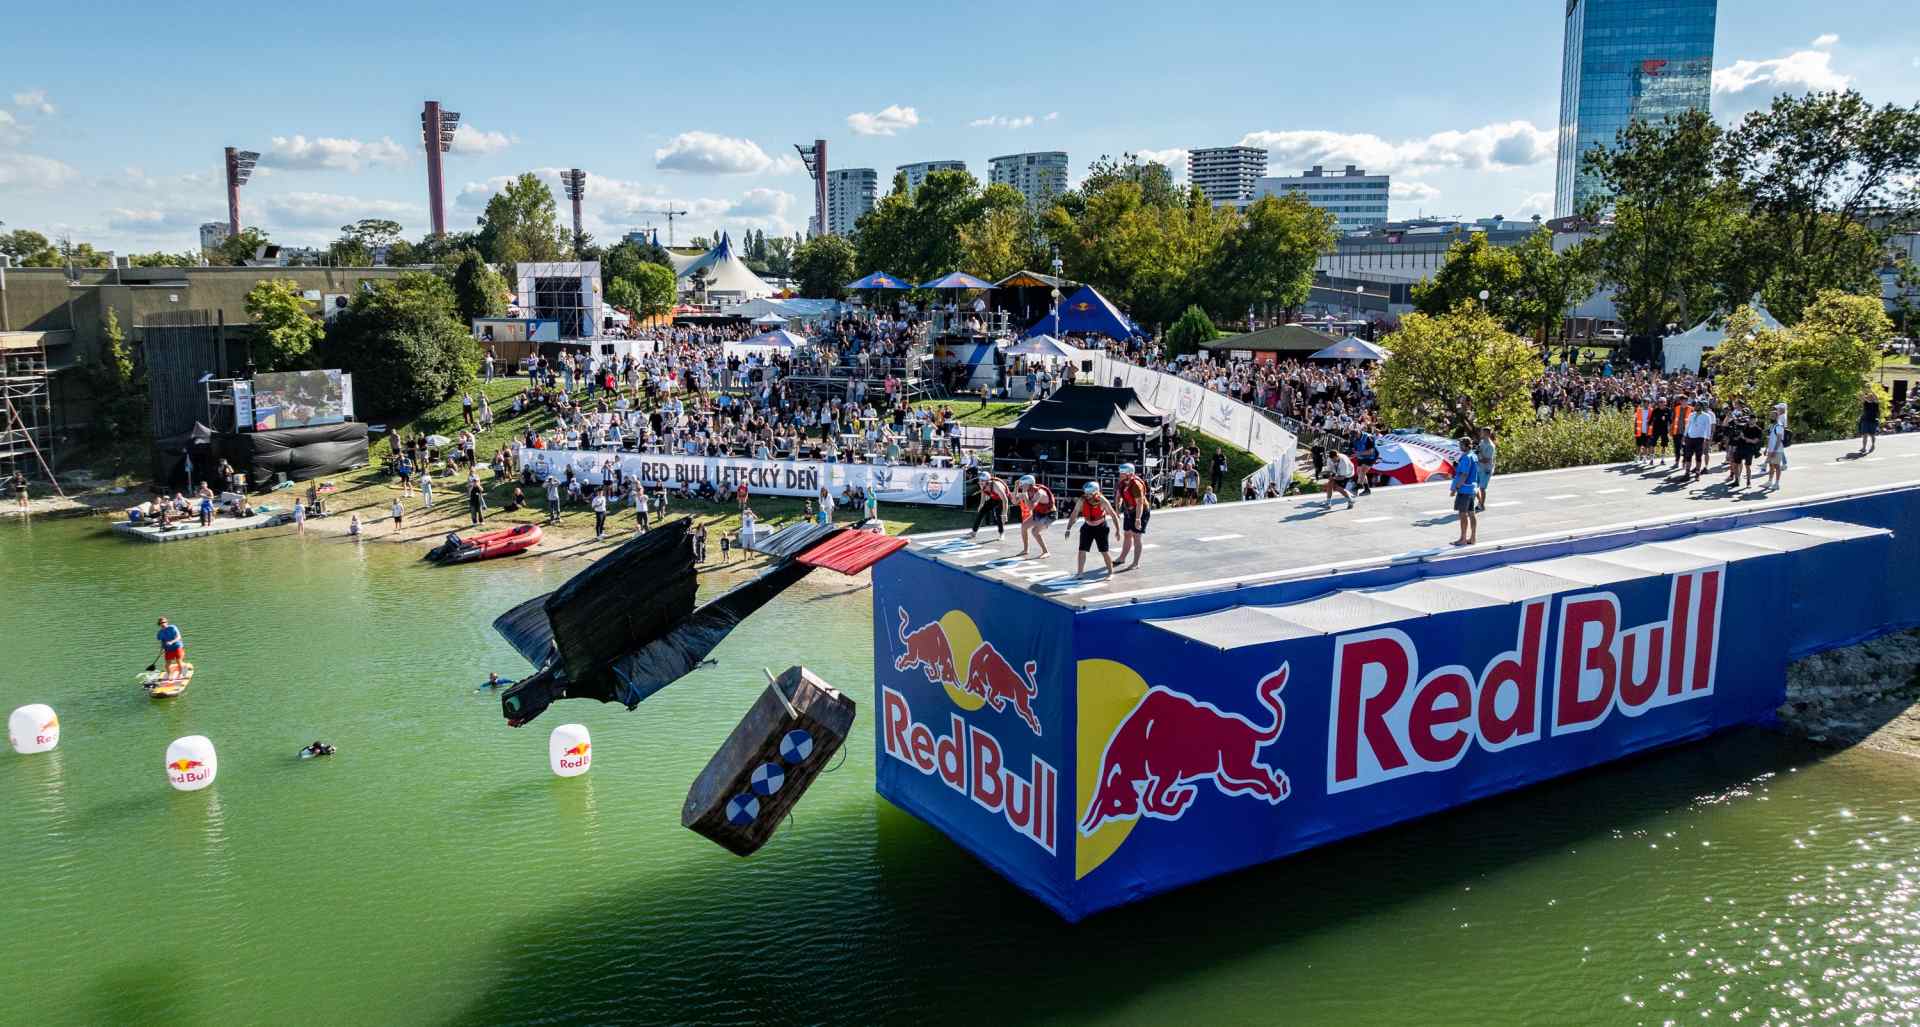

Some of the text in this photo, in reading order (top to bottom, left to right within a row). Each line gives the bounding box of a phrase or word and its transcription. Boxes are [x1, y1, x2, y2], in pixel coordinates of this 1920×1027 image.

[642, 462, 670, 482] RED
[786, 466, 818, 491] DEŇ
[1327, 563, 1726, 794] Red Bull
[186, 767, 210, 782] Bull
[560, 756, 582, 768] Red
[883, 685, 1057, 857] Red Bull
